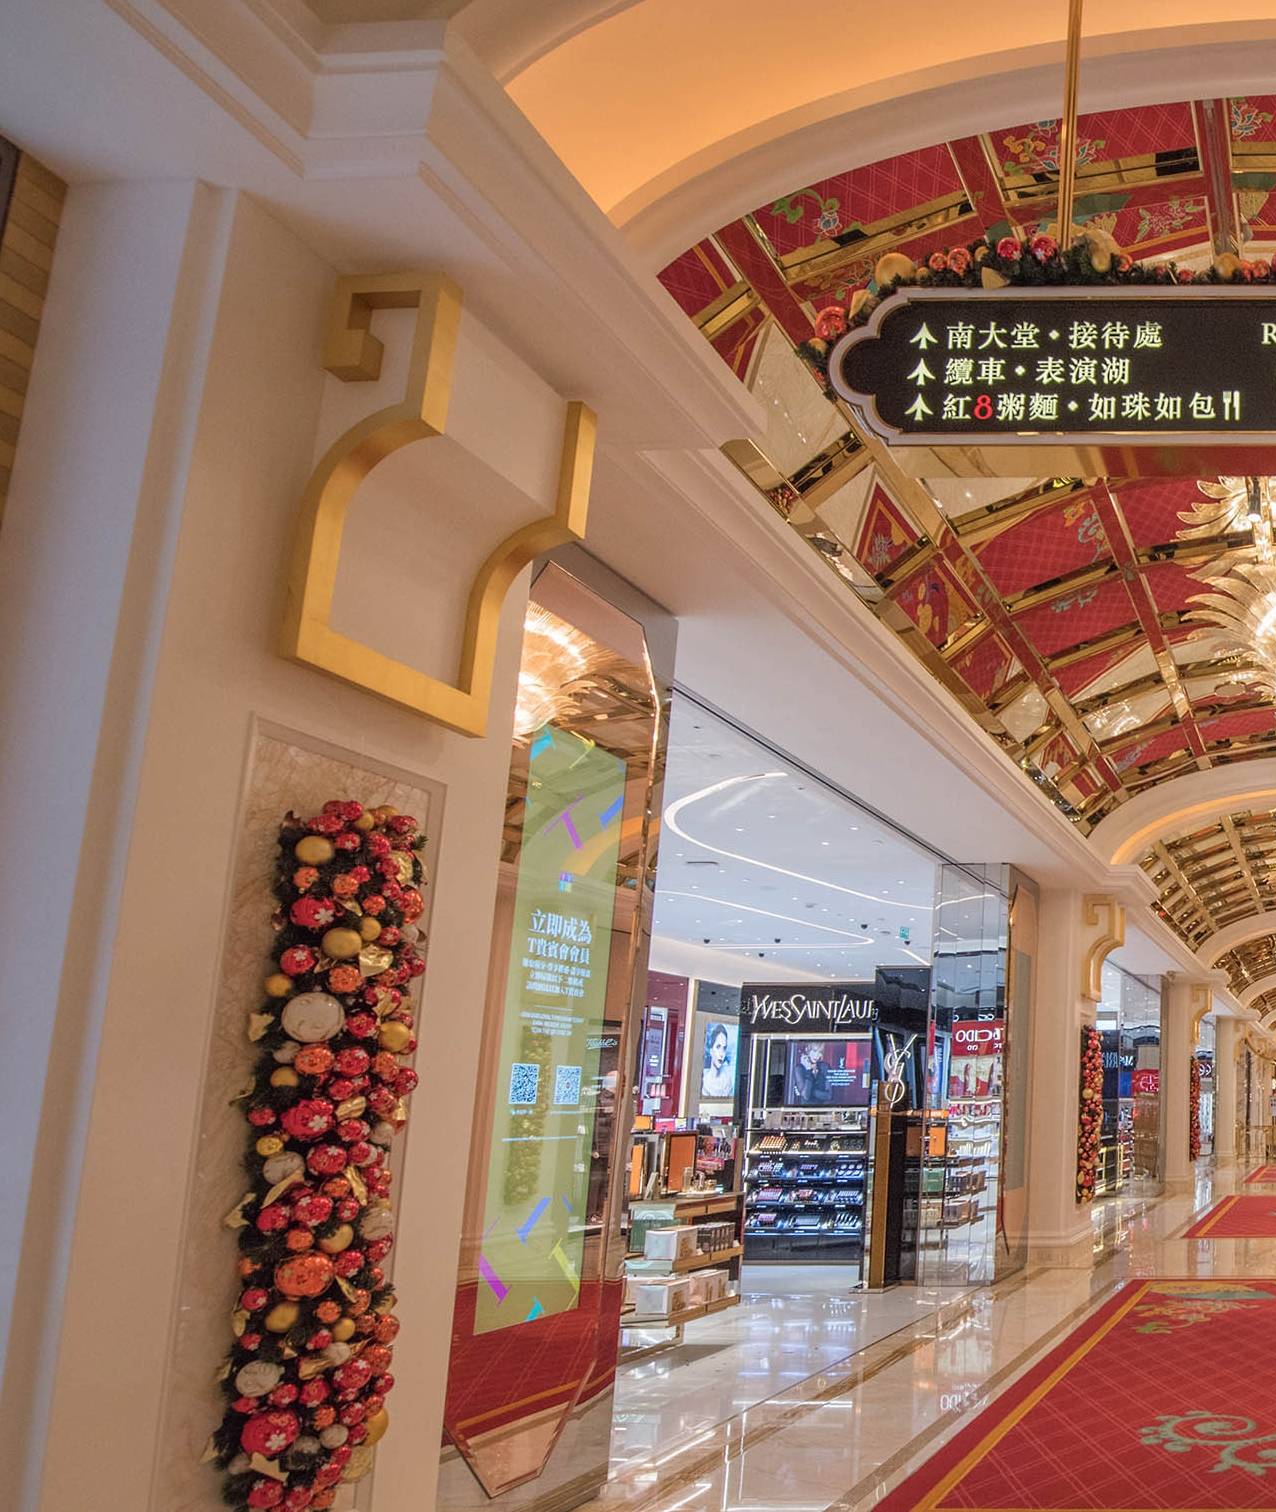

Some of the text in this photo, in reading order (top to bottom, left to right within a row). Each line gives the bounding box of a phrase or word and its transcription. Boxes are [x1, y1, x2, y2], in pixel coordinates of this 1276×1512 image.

[947, 321, 1162, 349] 南大堂 接待處
[944, 356, 1129, 385] 纜車 表演湖
[942, 392, 1216, 421] 紅8粥麵 如珠如包
[527, 908, 592, 944] 立即成為
